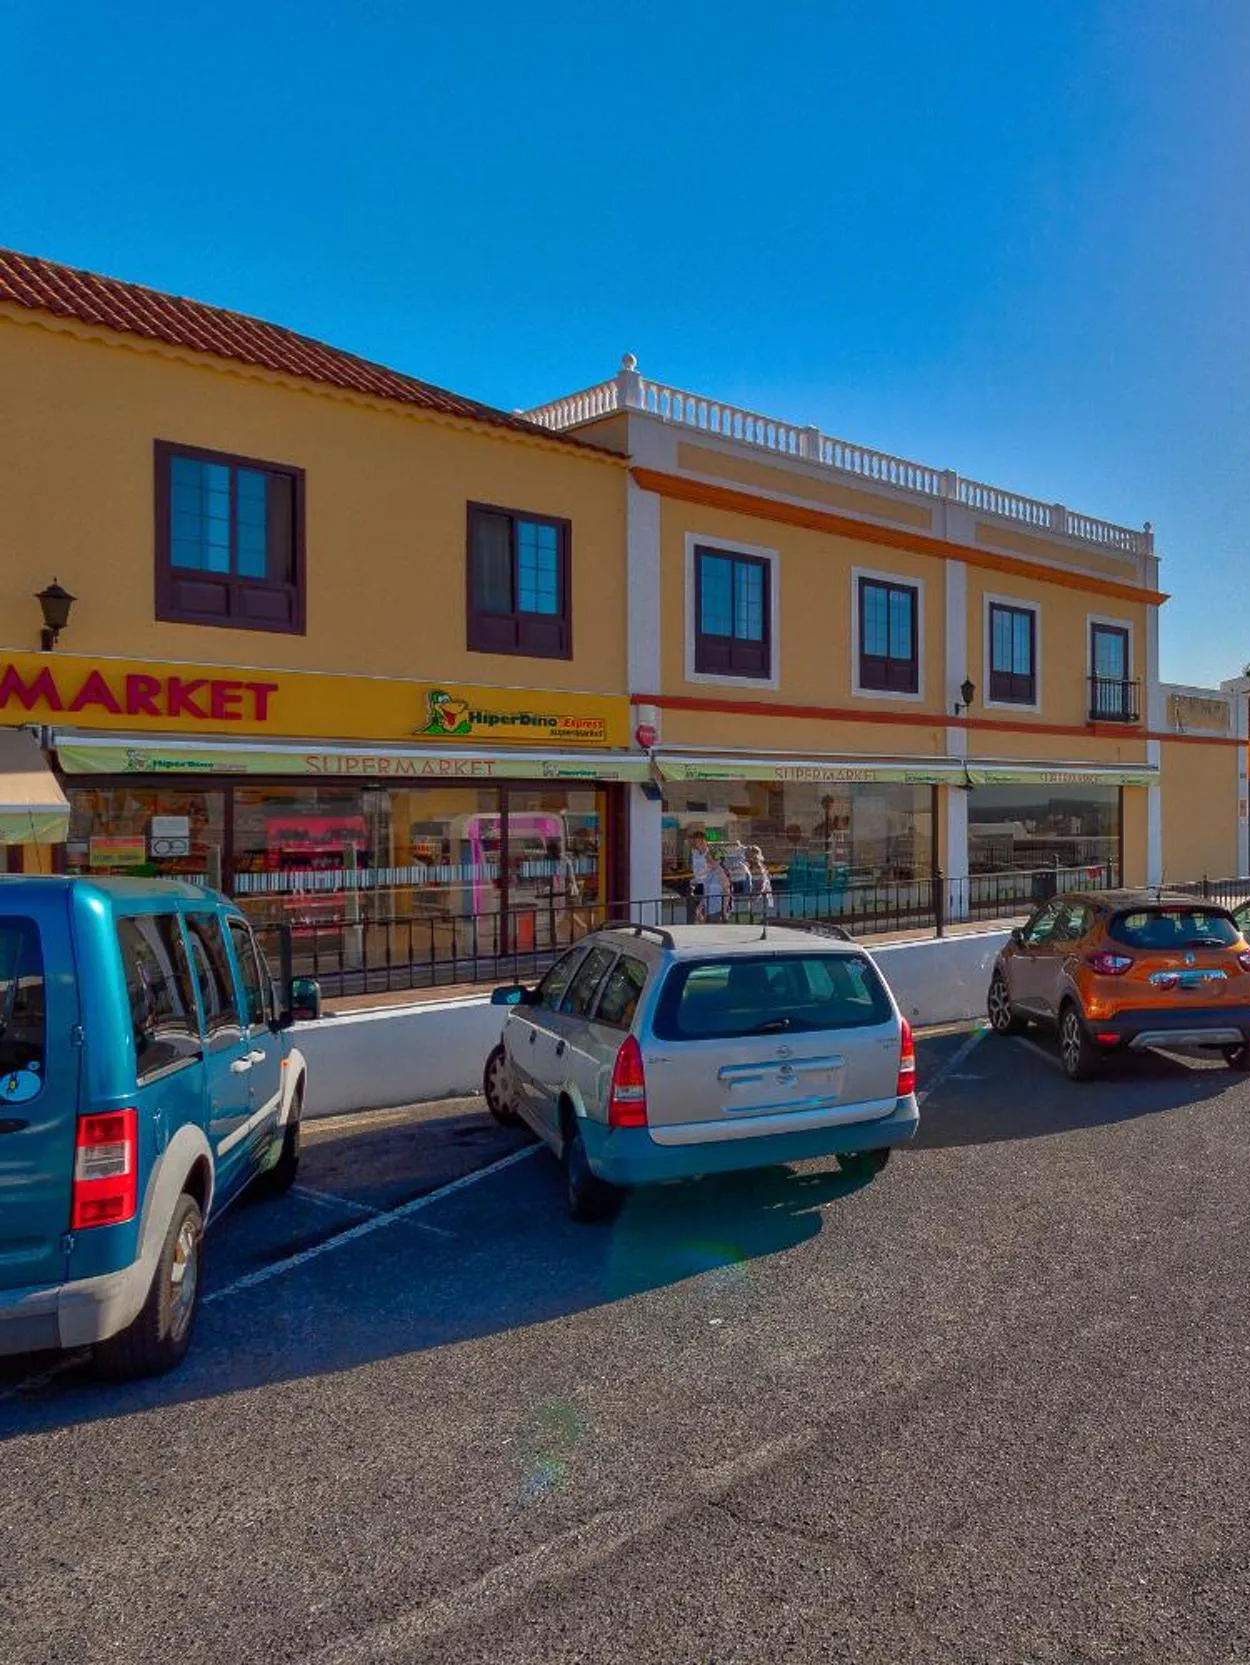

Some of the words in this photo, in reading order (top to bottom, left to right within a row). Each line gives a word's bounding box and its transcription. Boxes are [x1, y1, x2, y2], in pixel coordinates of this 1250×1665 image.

[0, 663, 279, 721] MARKET
[467, 711, 558, 727] HiperDino
[305, 755, 496, 776] SUPERMARKET
